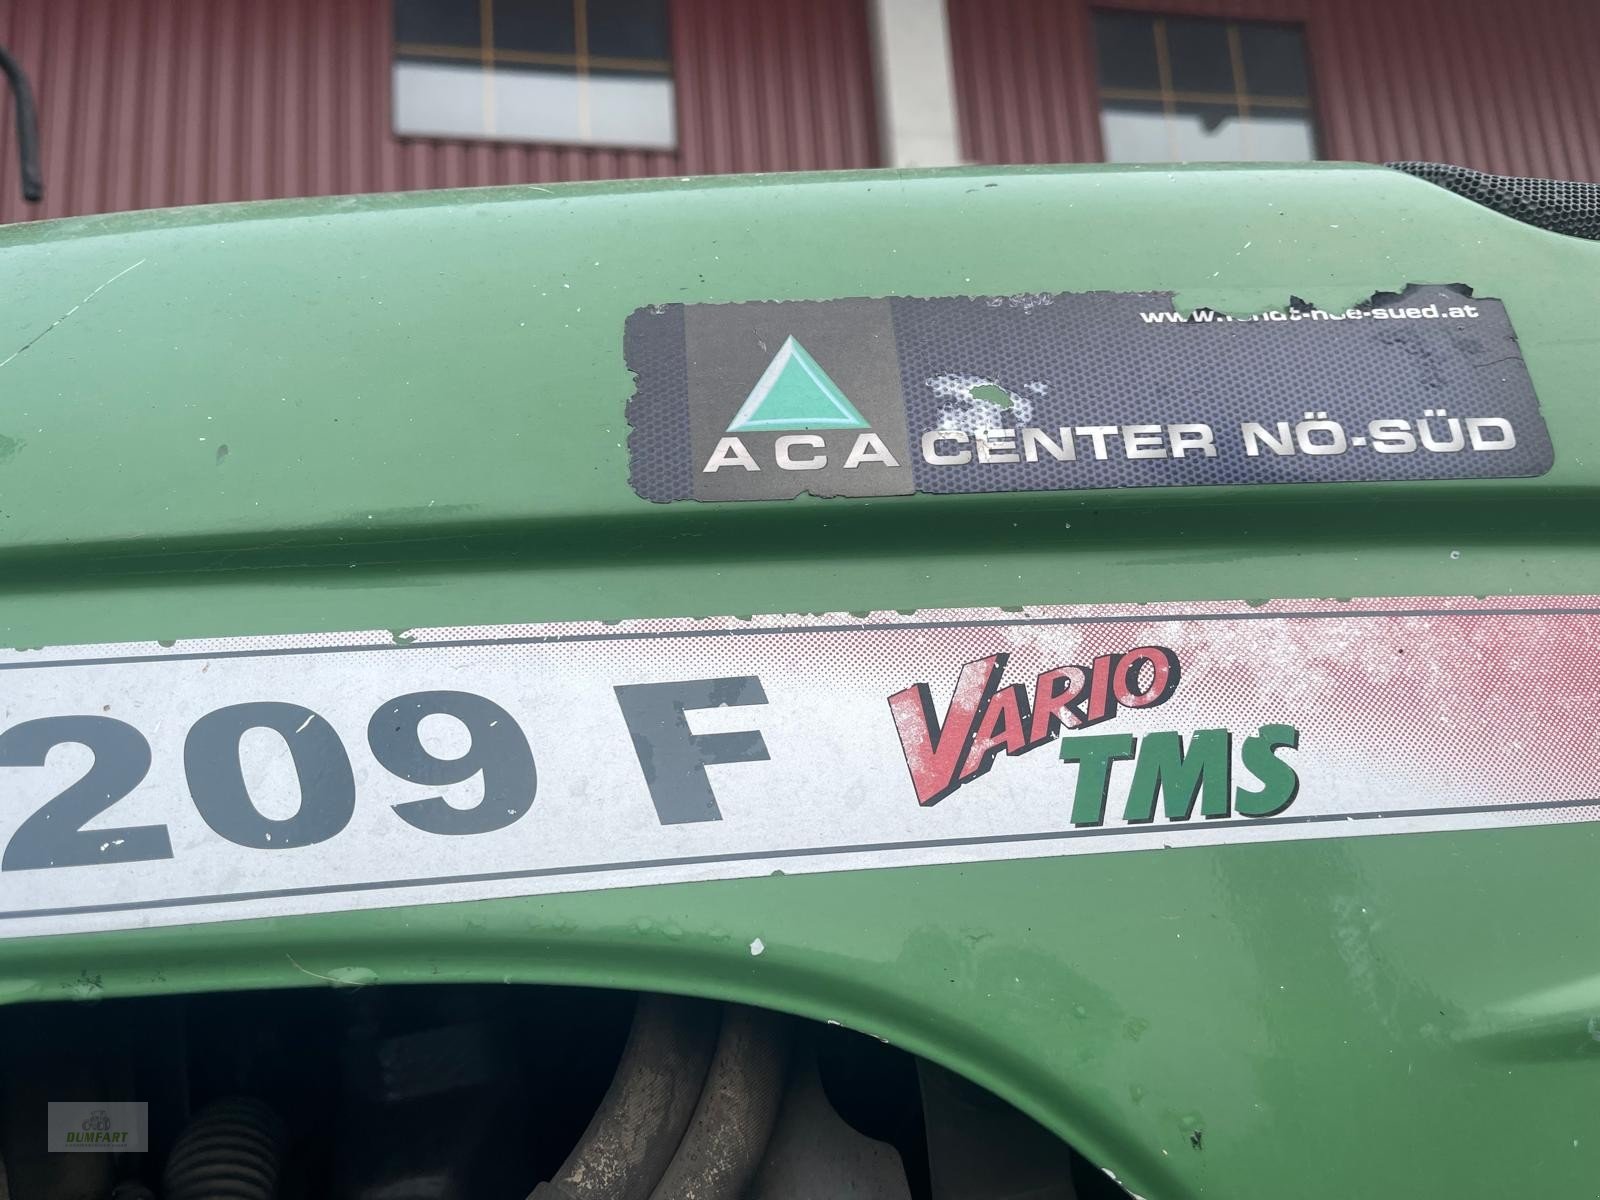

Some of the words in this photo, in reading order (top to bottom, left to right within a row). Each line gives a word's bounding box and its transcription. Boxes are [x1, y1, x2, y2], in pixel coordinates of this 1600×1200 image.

[921, 423, 1217, 466] CENTER
[1242, 408, 1517, 457] NÖ-SÜD
[0, 690, 537, 871] 209
[613, 675, 771, 826] F
[887, 645, 1181, 807] VARIO
[1059, 723, 1300, 828] TMS
